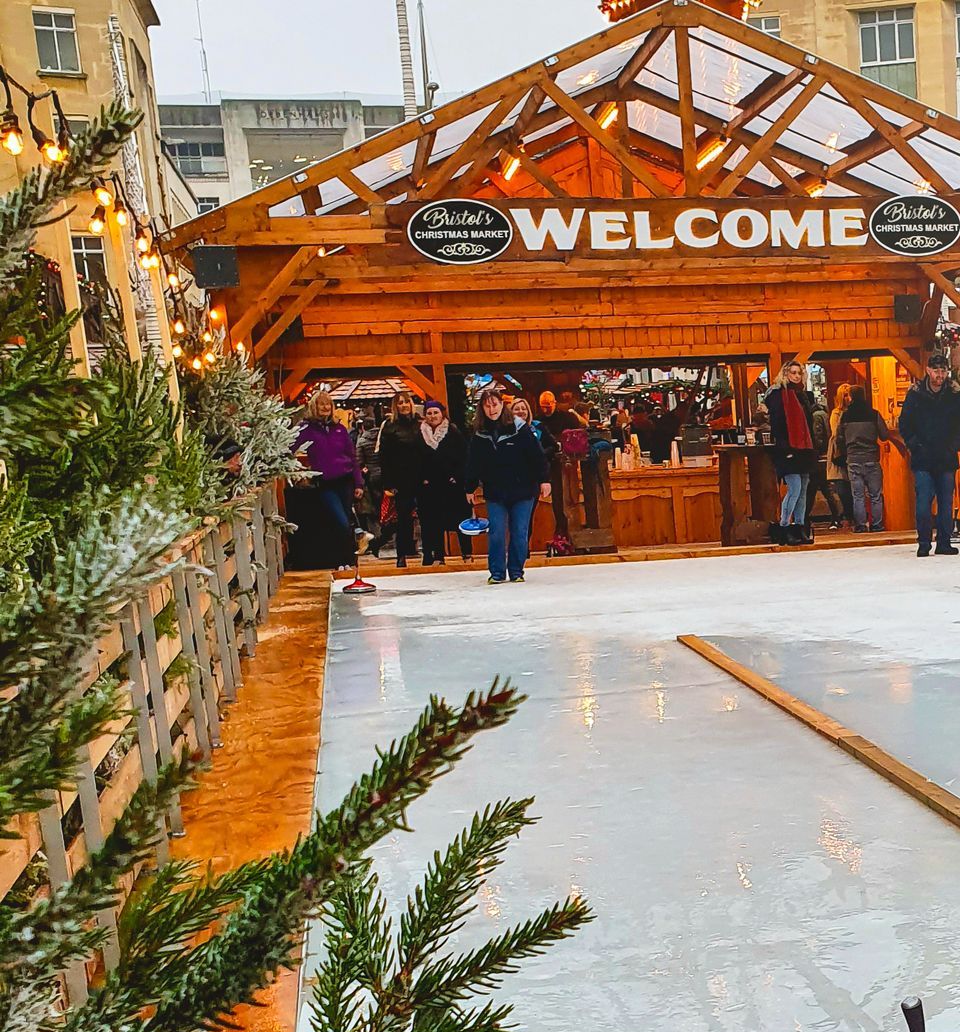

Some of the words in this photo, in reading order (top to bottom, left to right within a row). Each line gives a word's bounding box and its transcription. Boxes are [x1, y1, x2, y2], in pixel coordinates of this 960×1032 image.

[423, 207, 494, 229] Bristol's
[883, 202, 946, 223] Bristol's
[415, 231, 469, 239] CHRISTMAS
[471, 230, 509, 239] MARKET
[508, 207, 869, 250] WELCOME
[875, 224, 923, 232] CHRISTMAS
[925, 223, 959, 232] MARKET
